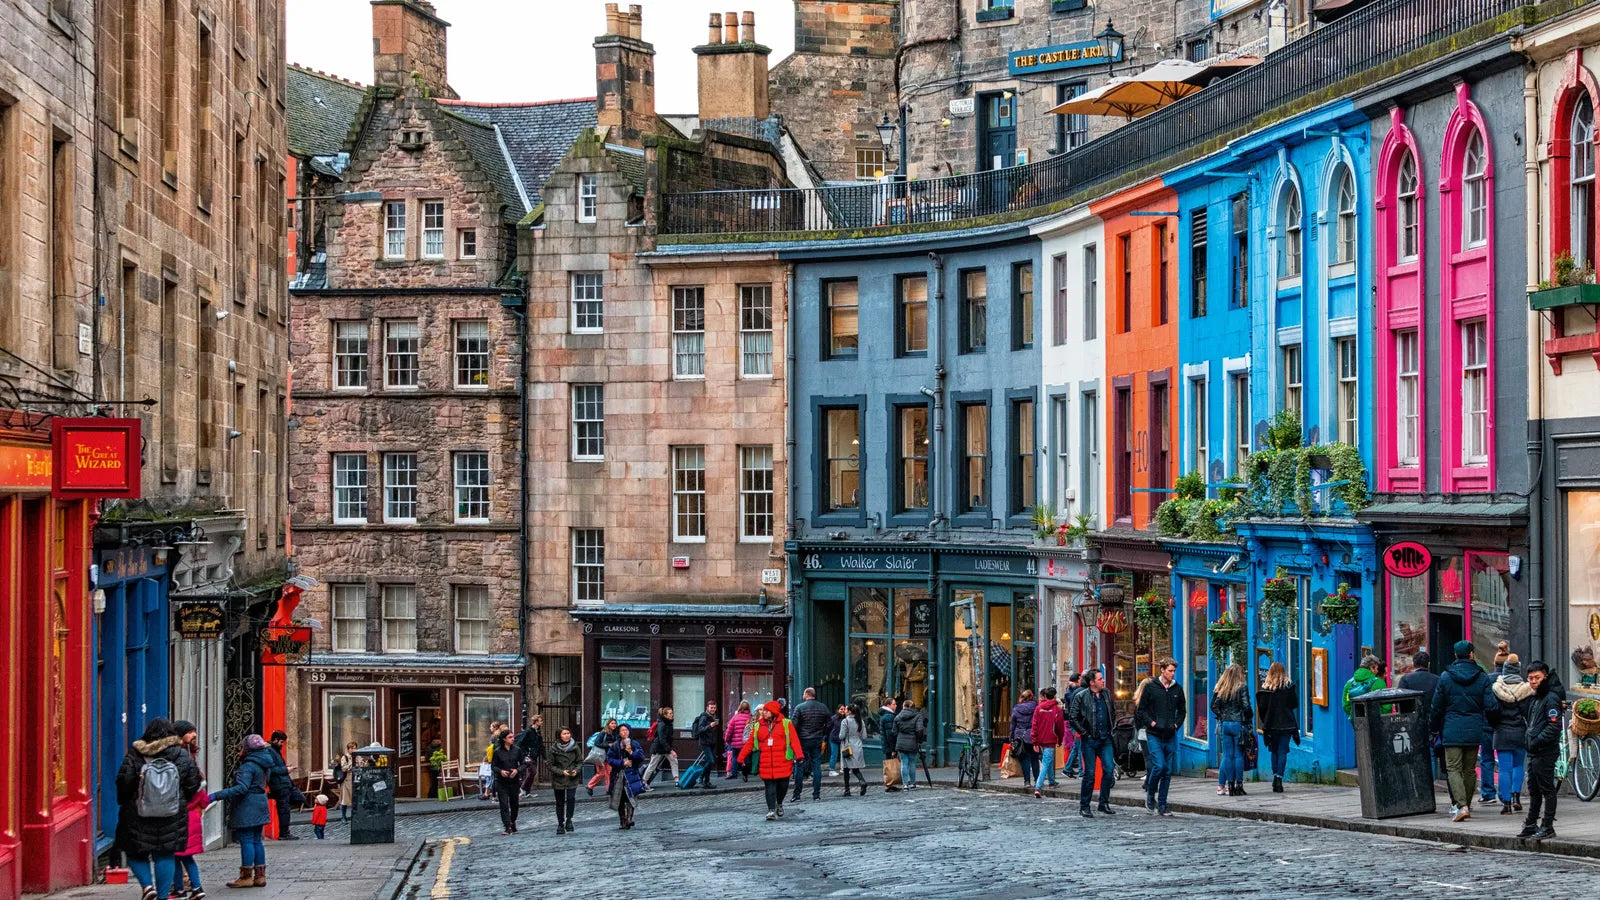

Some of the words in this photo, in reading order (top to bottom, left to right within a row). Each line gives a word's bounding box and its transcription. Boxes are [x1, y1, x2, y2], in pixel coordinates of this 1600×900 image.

[1014, 56, 1036, 68] THE
[1039, 49, 1080, 64] CASTLE
[75, 443, 92, 455] THE
[91, 447, 117, 459] GREAT
[74, 455, 121, 469] WIZARD
[840, 553, 879, 569] Walker
[885, 554, 918, 569] Slater
[974, 559, 1010, 571] LADIESWEAR
[603, 625, 640, 633] CLARKSONS
[726, 627, 763, 635] CLARKSONS
[311, 672, 327, 682] 89
[503, 675, 520, 685] 89
